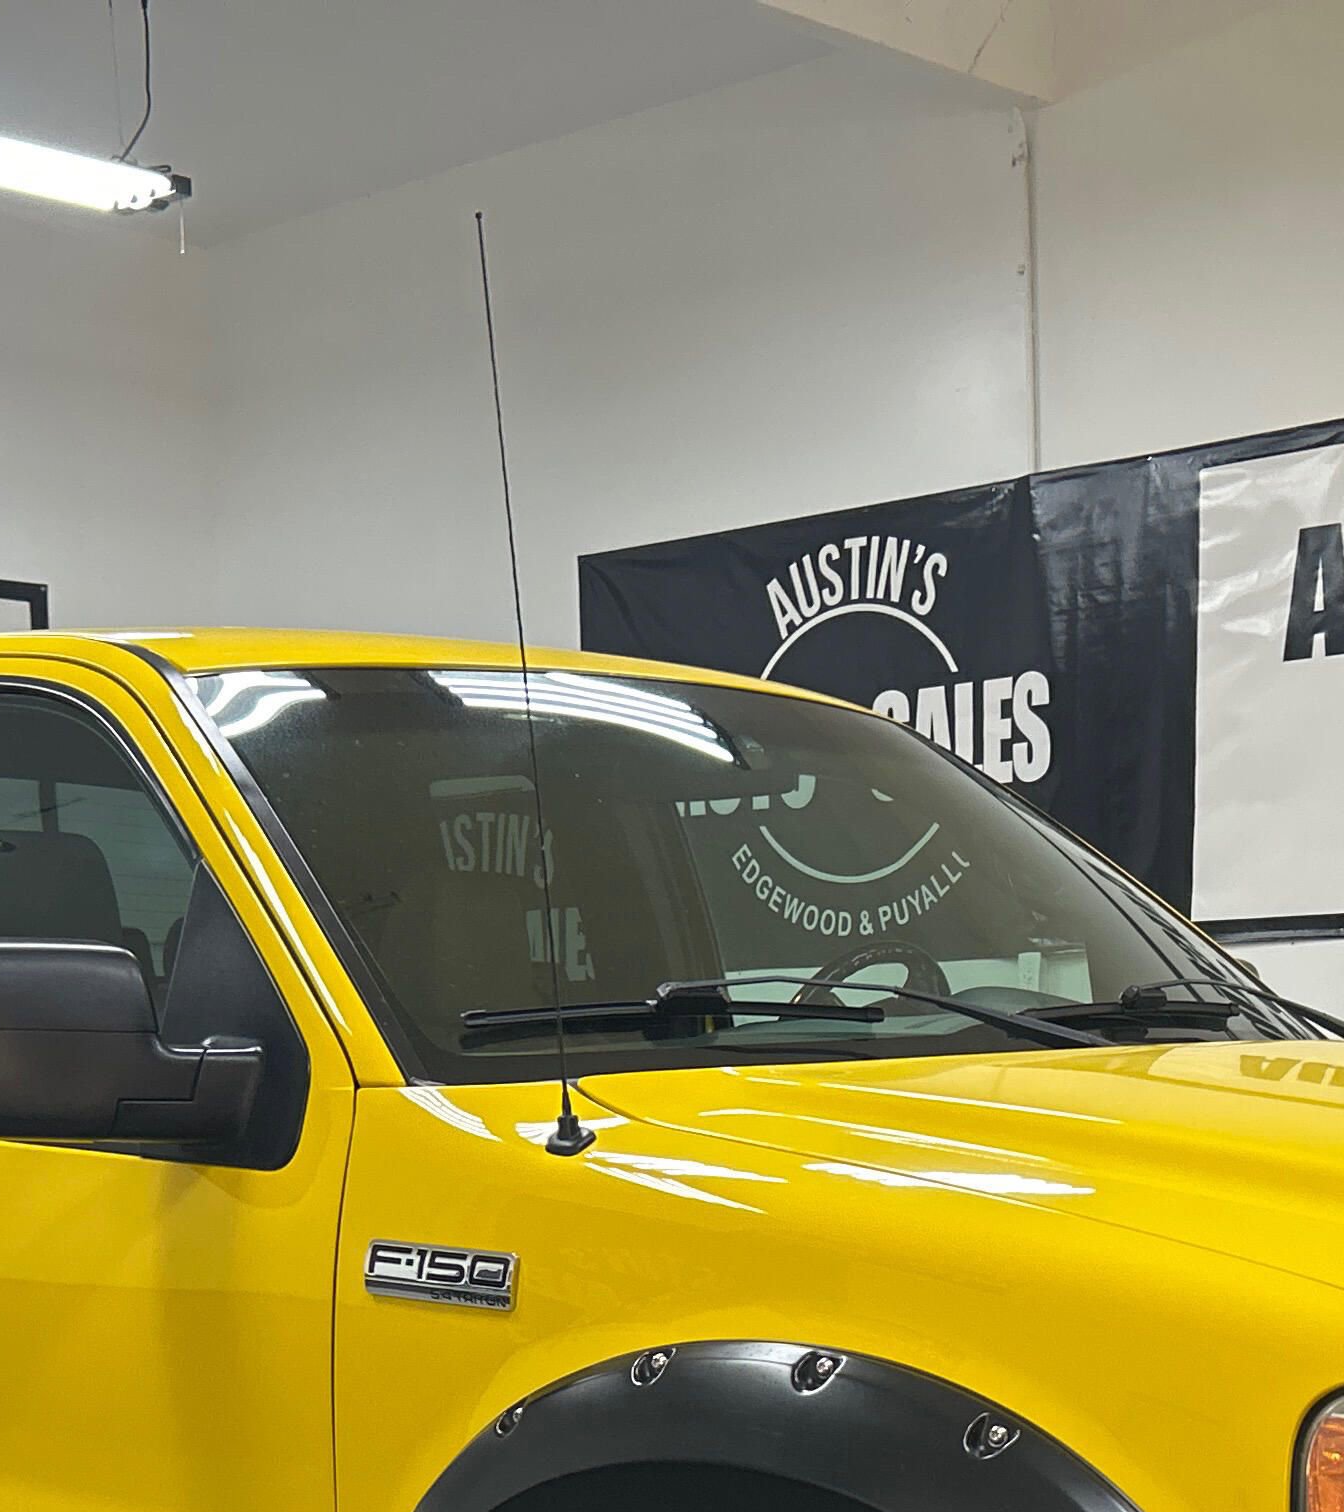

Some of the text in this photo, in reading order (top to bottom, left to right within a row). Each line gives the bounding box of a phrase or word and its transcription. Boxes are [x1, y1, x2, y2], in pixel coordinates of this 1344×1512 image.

[765, 535, 947, 639] AUSTIN'S
[731, 843, 970, 937] EDGEWOOD & PUYALL
